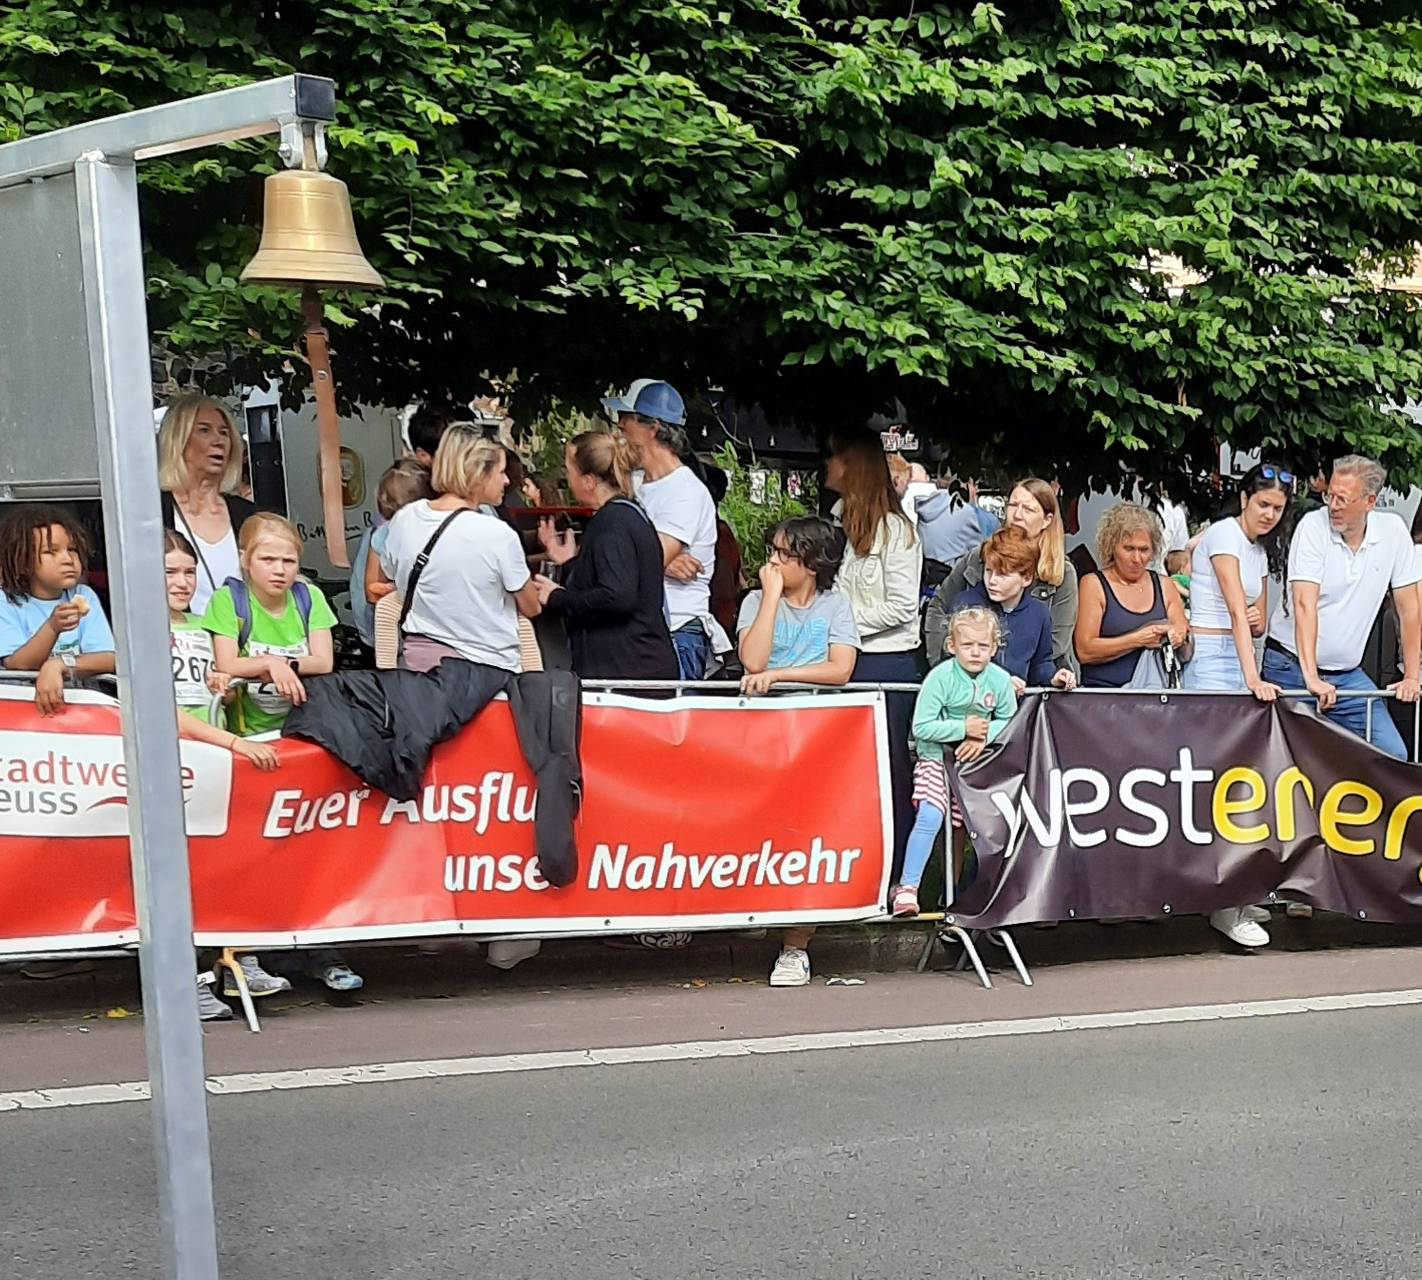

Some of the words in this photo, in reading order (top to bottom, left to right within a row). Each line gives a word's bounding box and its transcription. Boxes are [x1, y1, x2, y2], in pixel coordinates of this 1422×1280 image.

[0, 750, 195, 789] adtwee
[0, 787, 78, 815] euss
[262, 784, 371, 838] Euer
[379, 771, 539, 835] Ausflu
[443, 854, 553, 892] unse
[587, 837, 862, 890] Nahverkehr
